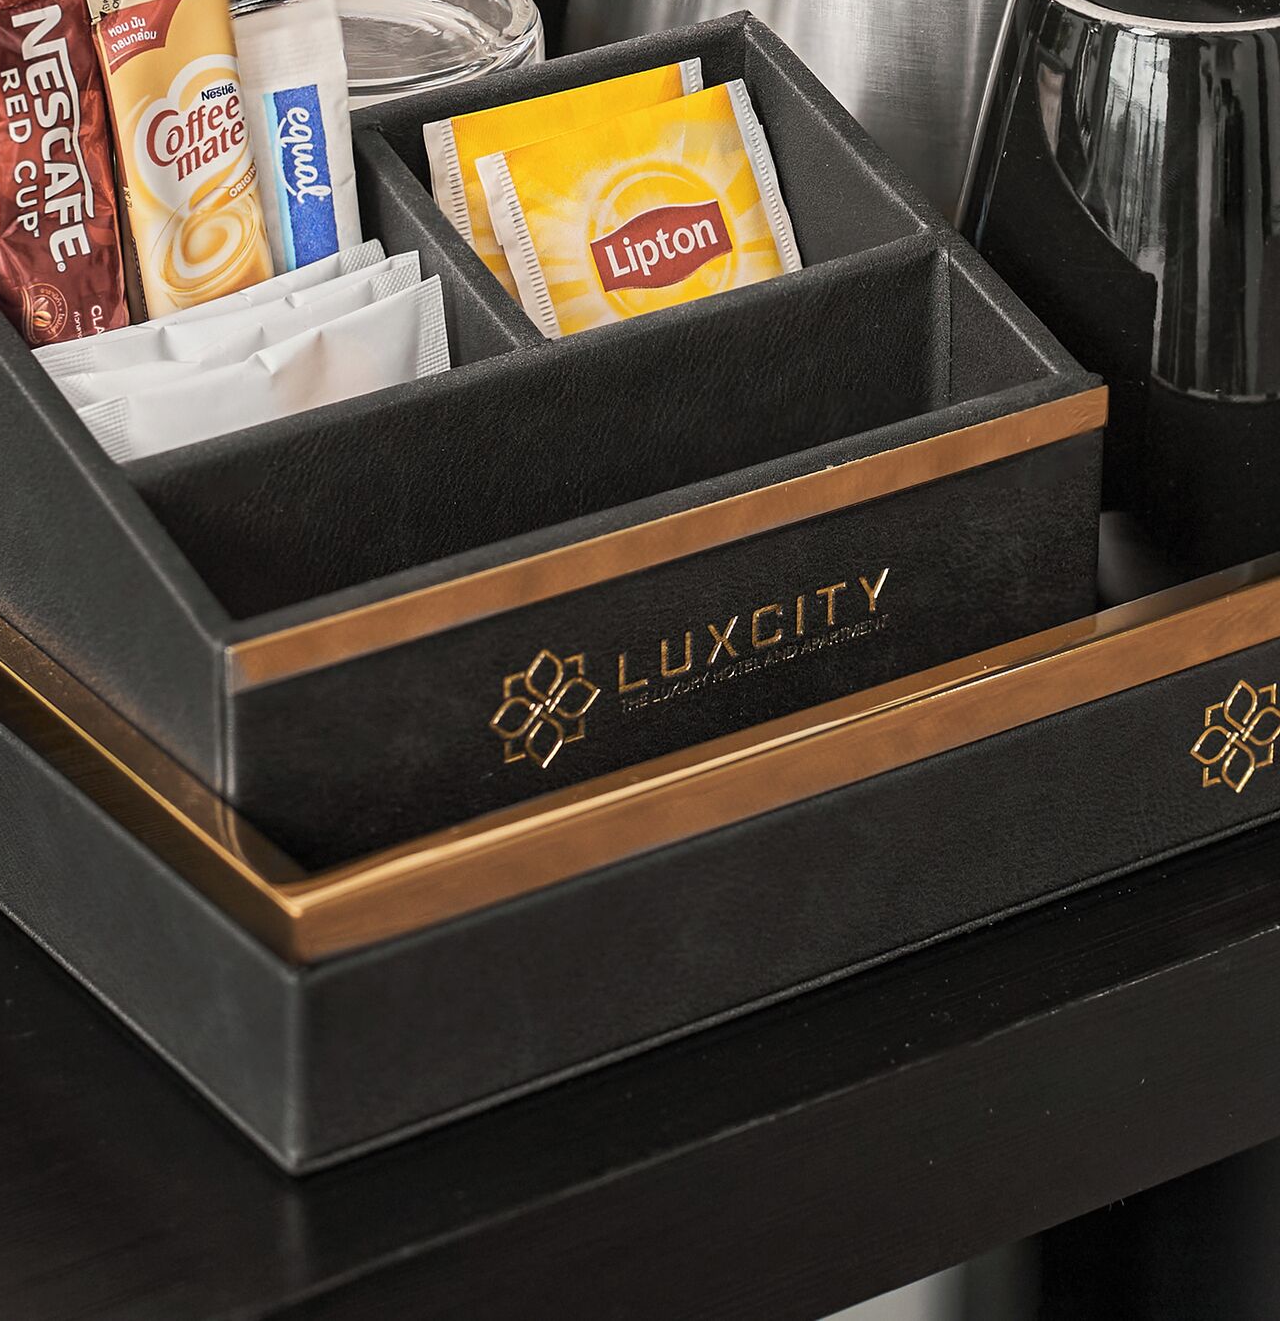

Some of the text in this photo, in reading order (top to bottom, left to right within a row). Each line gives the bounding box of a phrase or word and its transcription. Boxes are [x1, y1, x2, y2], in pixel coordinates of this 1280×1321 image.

[108, 16, 146, 38] หอม มัน
[111, 28, 157, 53] กลมกล่อม
[0, 68, 40, 235] RED CUP
[146, 95, 239, 167] Coffee
[176, 120, 244, 182] mate
[278, 106, 333, 205] equal
[604, 218, 719, 279] Lipton
[618, 567, 890, 693] LUXCITY
